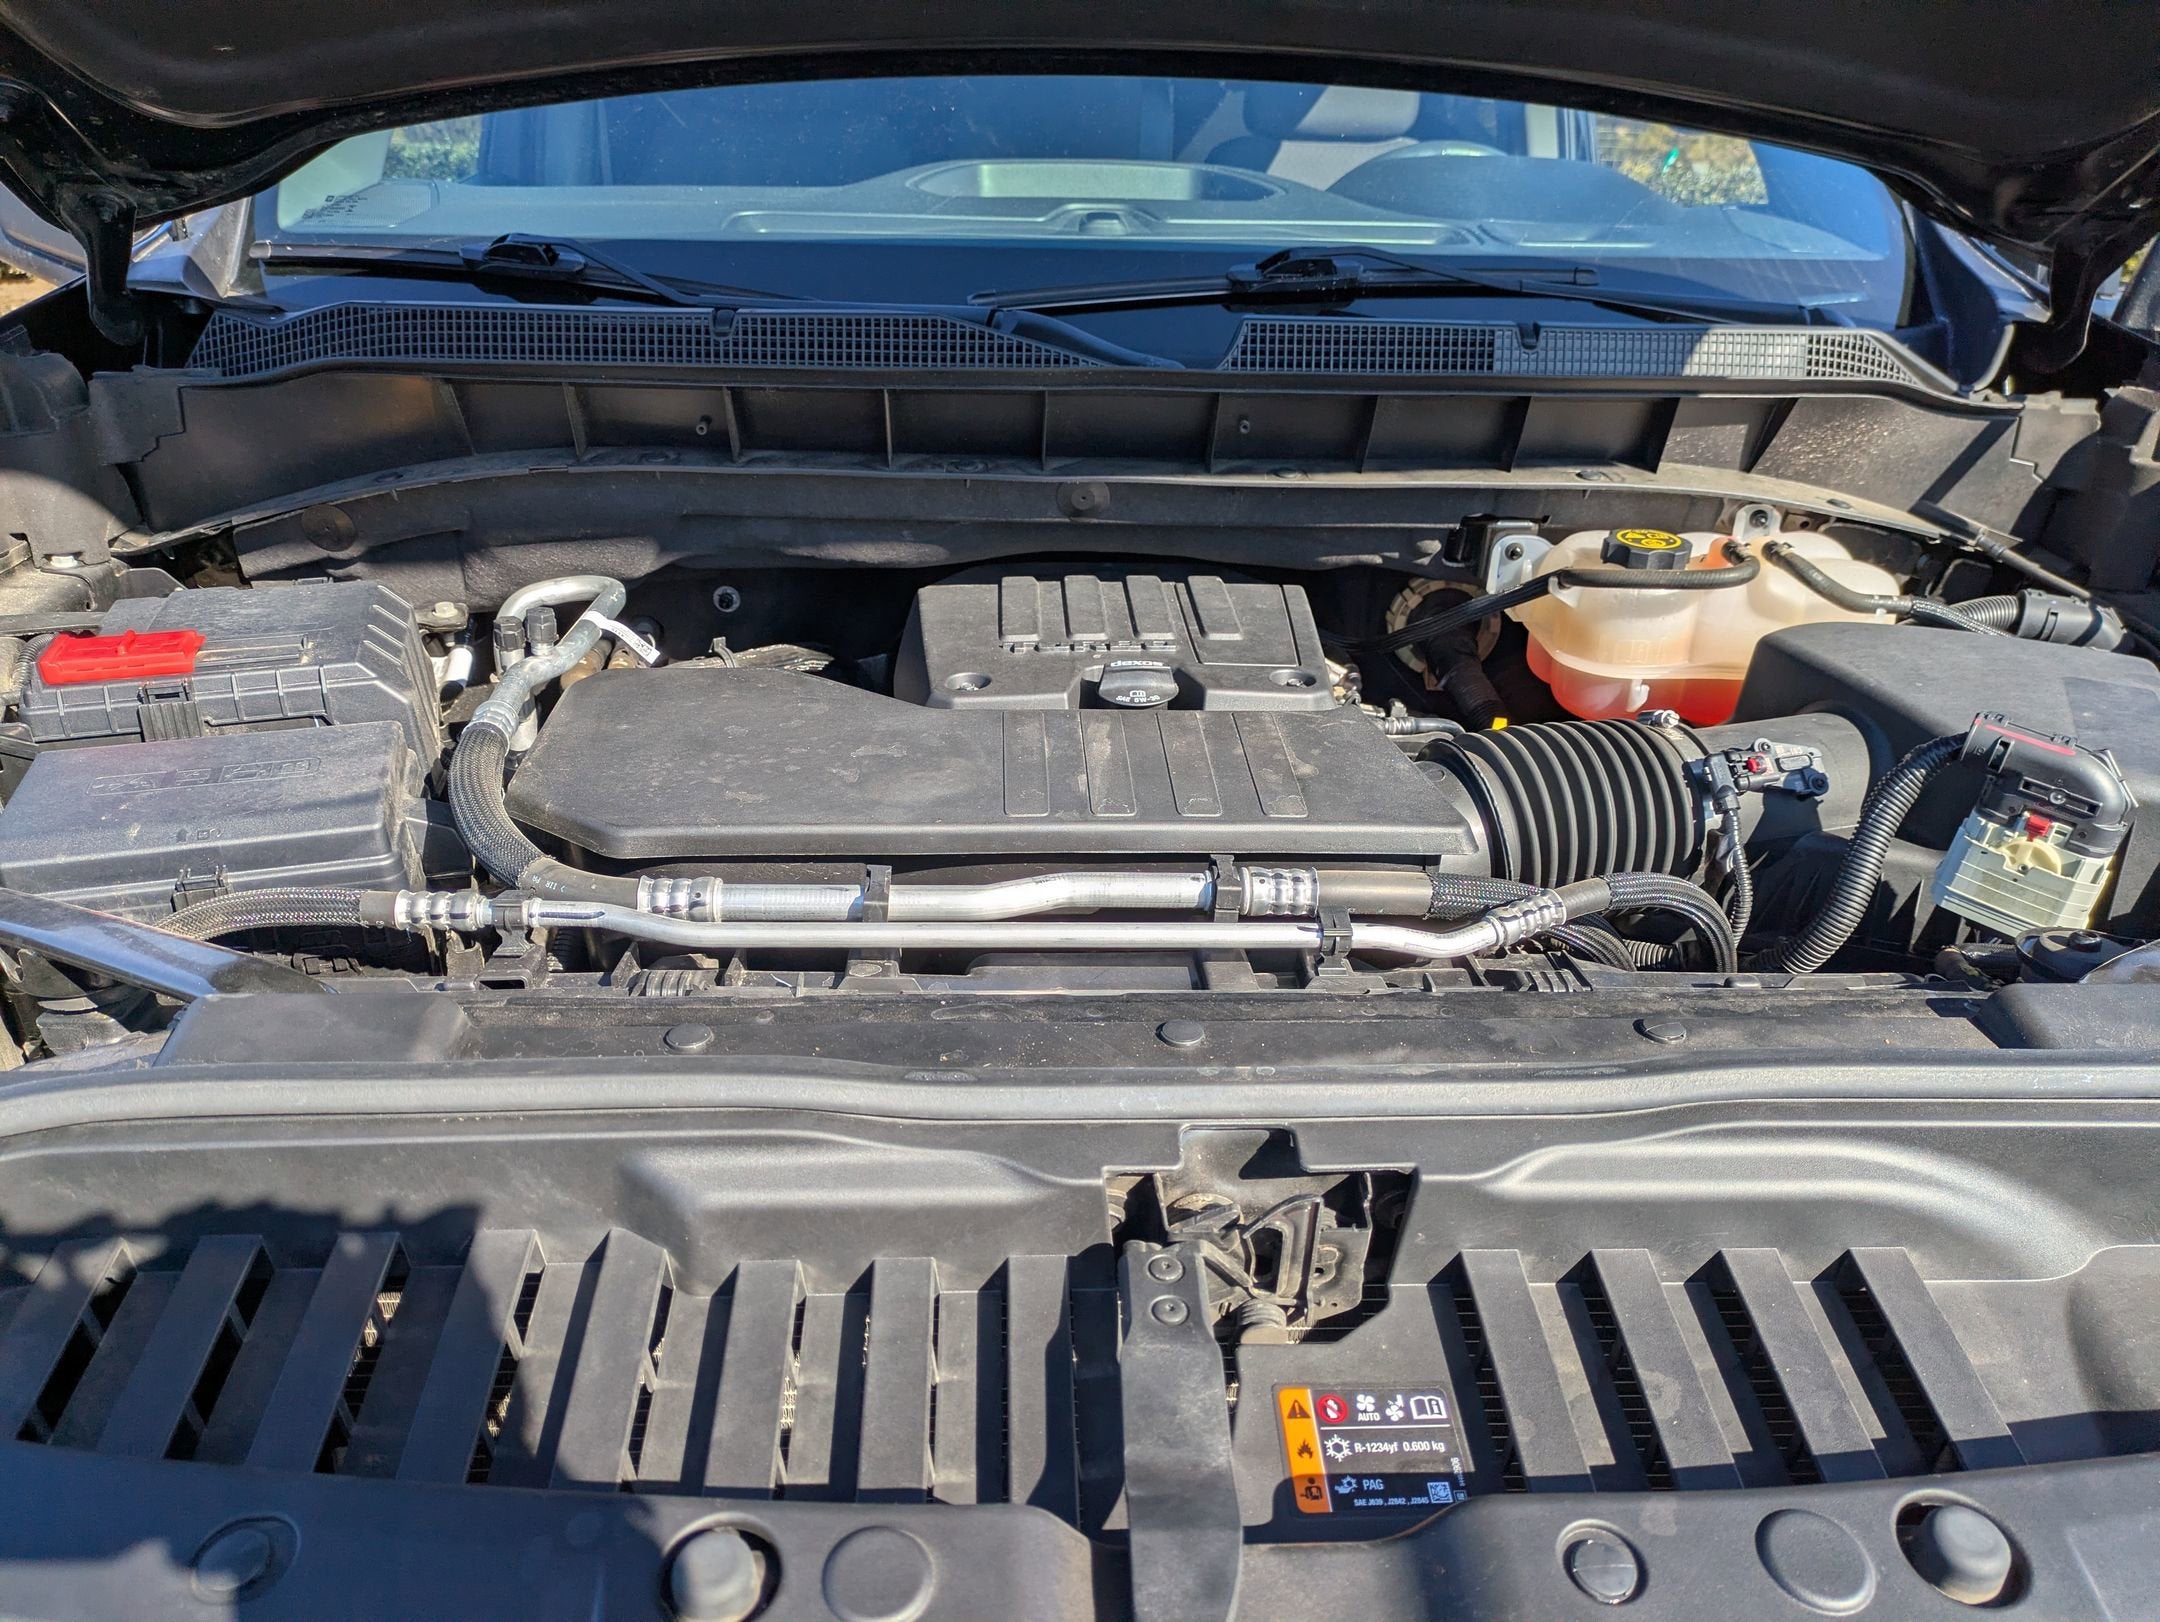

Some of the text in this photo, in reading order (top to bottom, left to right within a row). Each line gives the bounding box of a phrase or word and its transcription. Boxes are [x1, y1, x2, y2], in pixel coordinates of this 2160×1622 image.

[1357, 1412, 1381, 1422] AUTO
[1354, 1440, 1446, 1454] R-1234yf 0.600 kg
[1362, 1478, 1385, 1490] PAG
[1353, 1498, 1367, 1506] SAE
